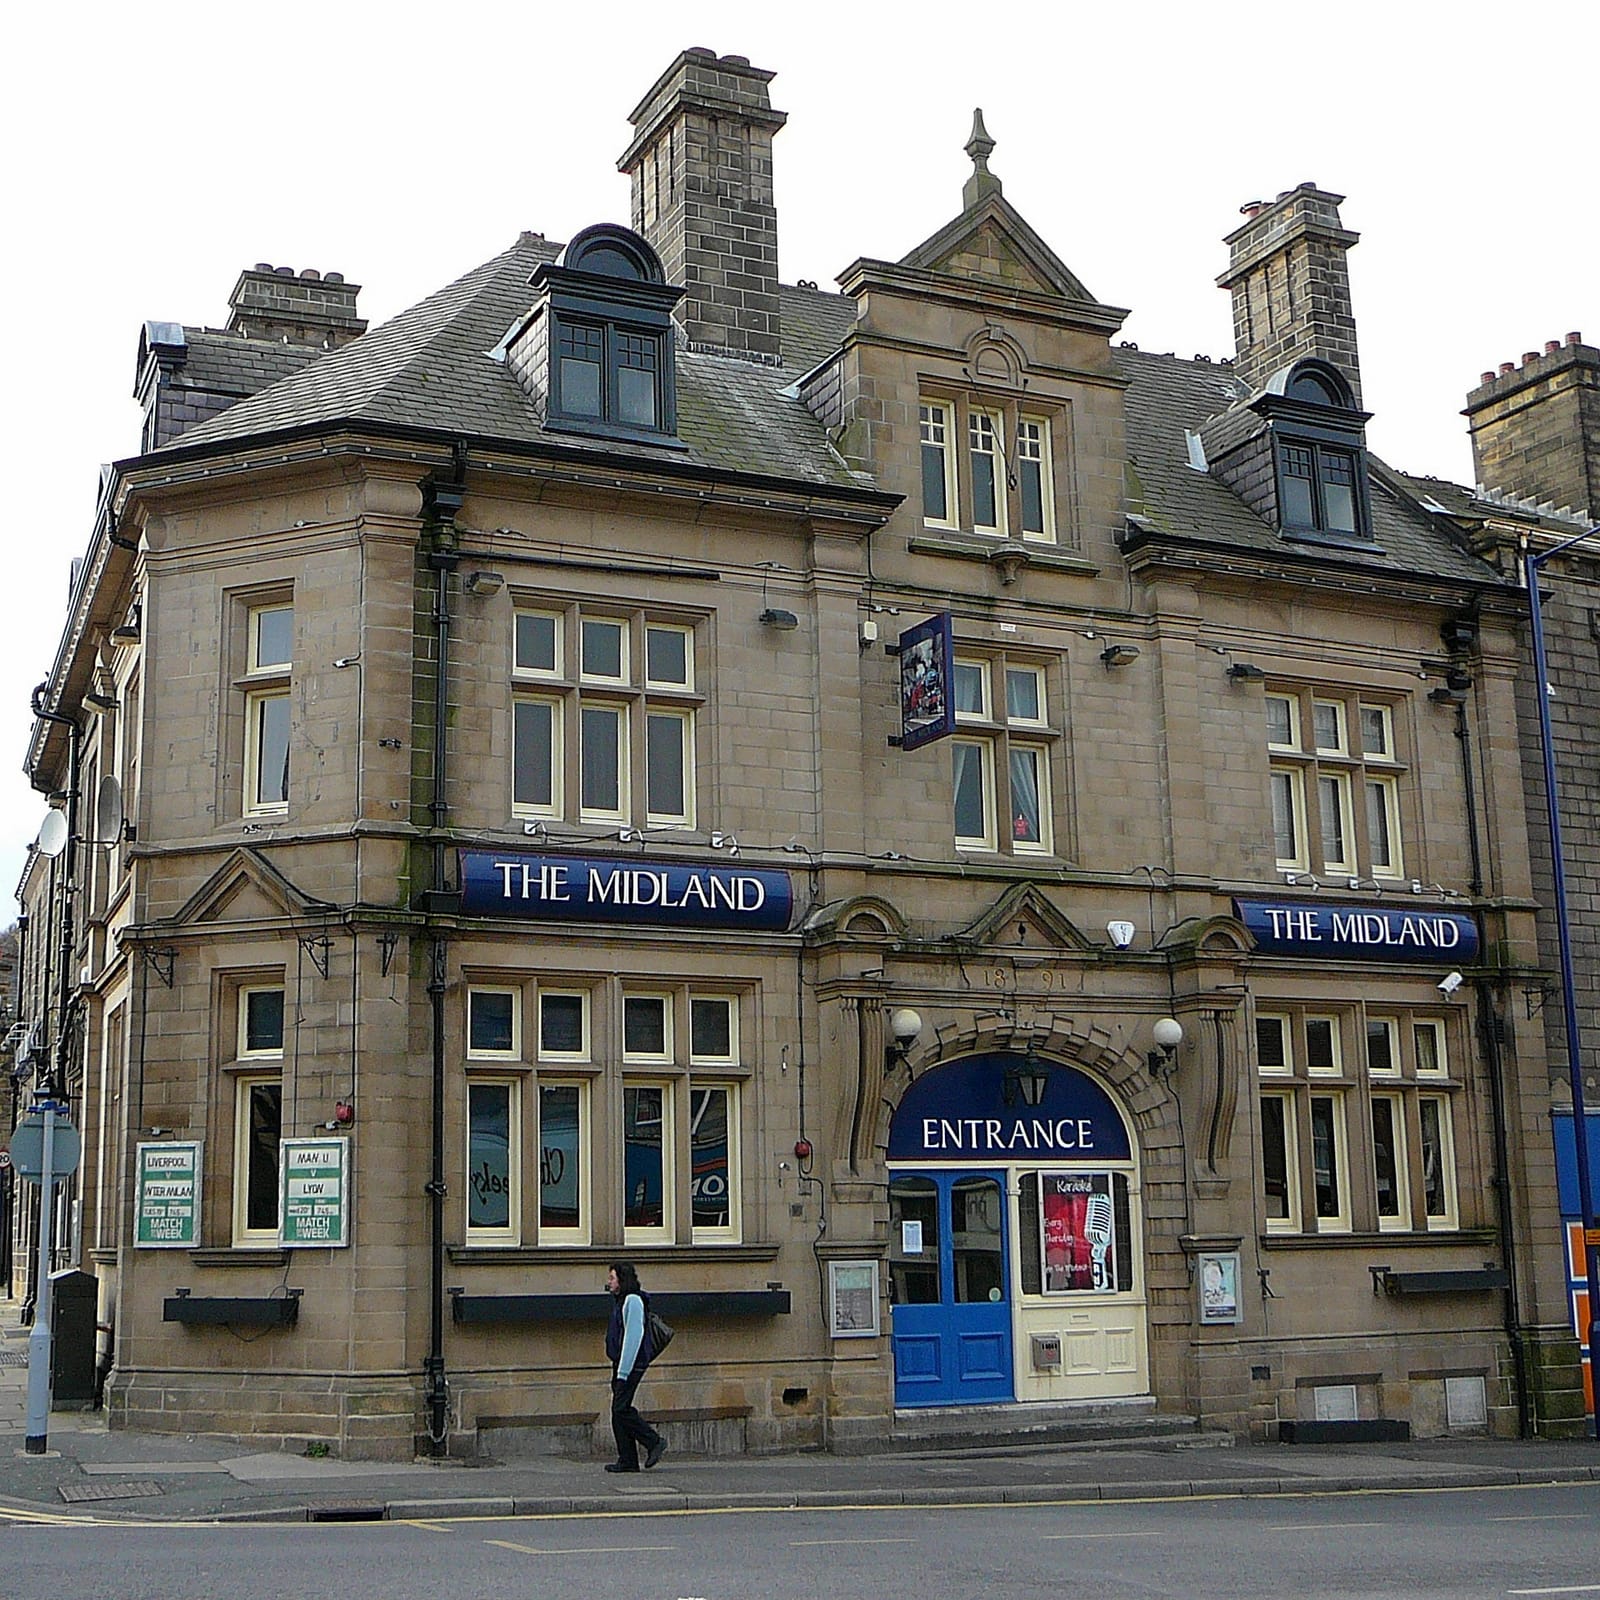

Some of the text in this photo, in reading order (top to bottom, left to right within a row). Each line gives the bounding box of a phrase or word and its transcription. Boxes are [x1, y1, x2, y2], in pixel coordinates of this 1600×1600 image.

[494, 863, 765, 911] THE MIDLAND
[1265, 910, 1459, 947] THE MIDLAND
[922, 1119, 1094, 1149] ENTRANCE
[147, 1157, 187, 1167] LIVERPOOL
[297, 1153, 329, 1164] MAN U
[303, 1183, 324, 1194] LYON
[1056, 1179, 1093, 1193] Karaoke
[150, 1218, 182, 1228] MATCH
[296, 1217, 330, 1228] MATCH
[156, 1229, 182, 1239] WEEK
[303, 1228, 330, 1239] WEEK
